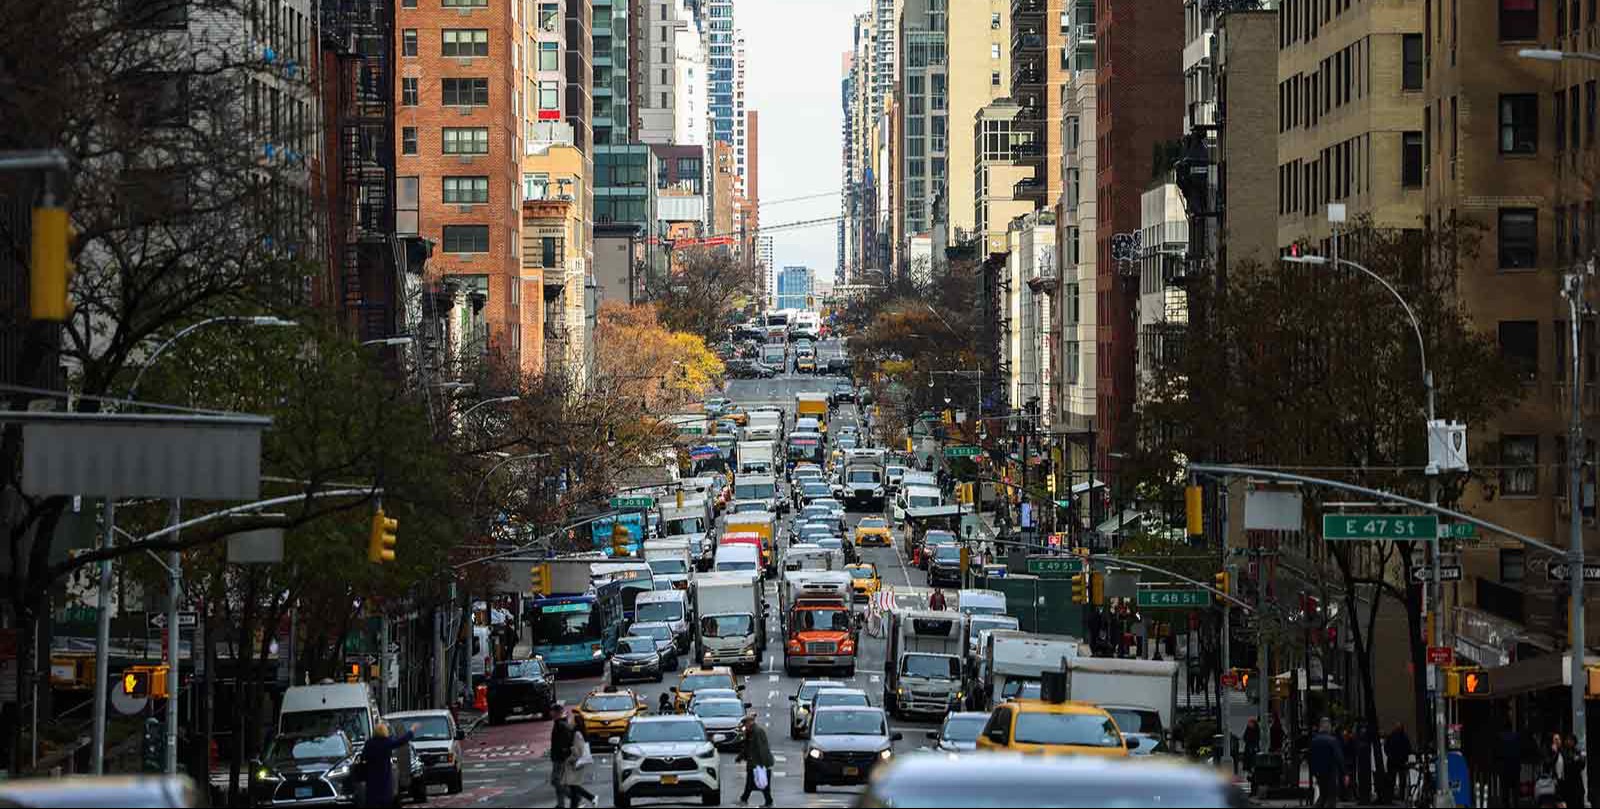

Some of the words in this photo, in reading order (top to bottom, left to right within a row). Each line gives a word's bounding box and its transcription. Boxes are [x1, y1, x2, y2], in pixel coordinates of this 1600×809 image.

[1346, 519, 1357, 534] E
[1363, 519, 1387, 534] 47
[1394, 519, 1416, 535] St
[1151, 593, 1158, 603] E
[1162, 593, 1178, 603] 48
[1184, 593, 1197, 603] St
